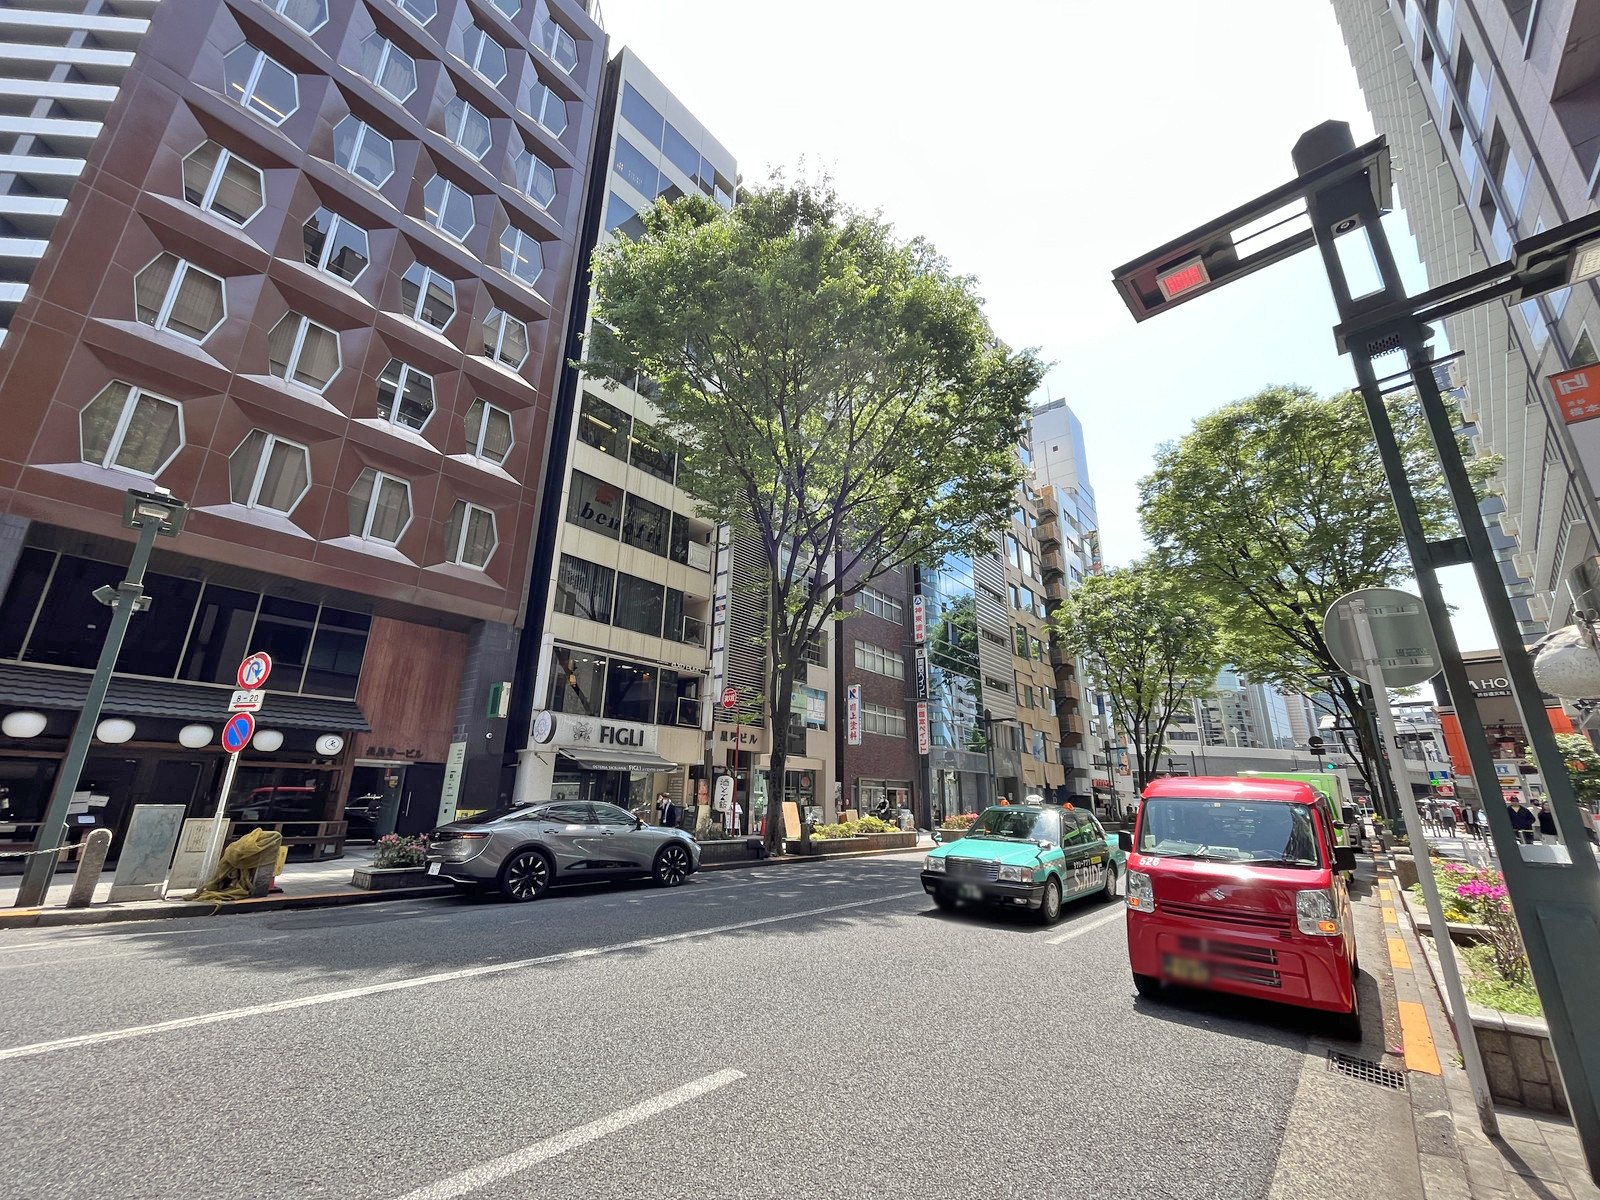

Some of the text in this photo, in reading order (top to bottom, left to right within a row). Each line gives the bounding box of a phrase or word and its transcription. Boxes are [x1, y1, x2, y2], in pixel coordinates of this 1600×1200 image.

[600, 725, 644, 747] FIGLI
[918, 711, 927, 753] 日本ペイント
[1139, 857, 1160, 866] 526
[1074, 863, 1103, 892] S.RIDE
